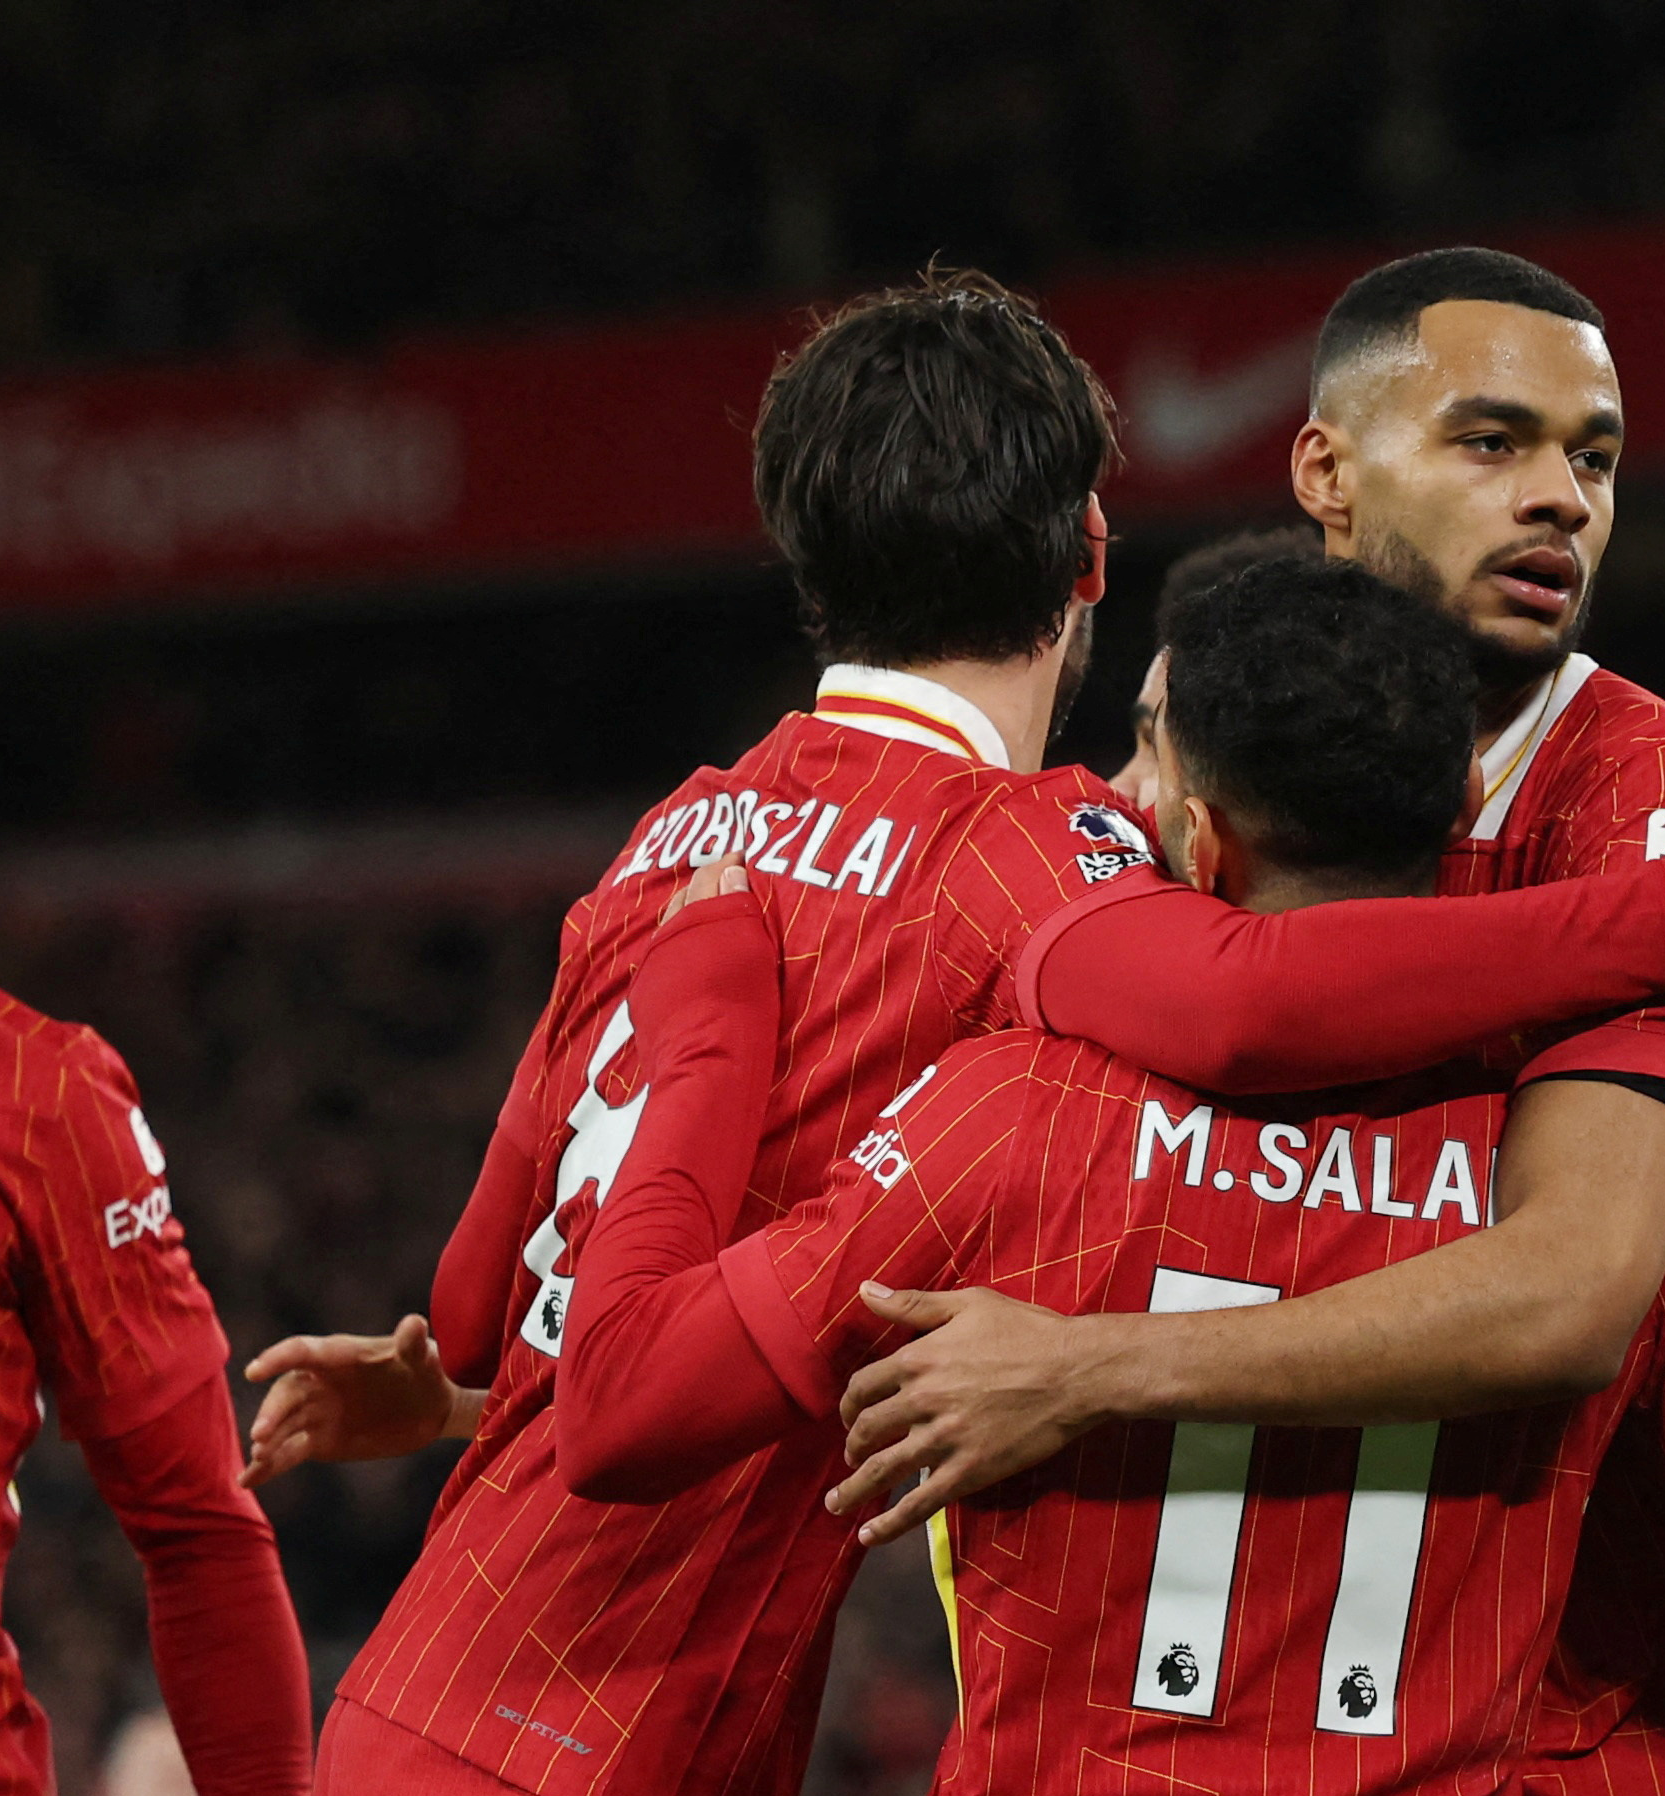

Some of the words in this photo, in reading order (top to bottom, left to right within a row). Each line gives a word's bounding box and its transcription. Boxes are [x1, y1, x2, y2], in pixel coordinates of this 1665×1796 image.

[104, 1185, 172, 1249] Exp
[1133, 1099, 1500, 1229] M.SALA
[1131, 1265, 1442, 1737] 11
